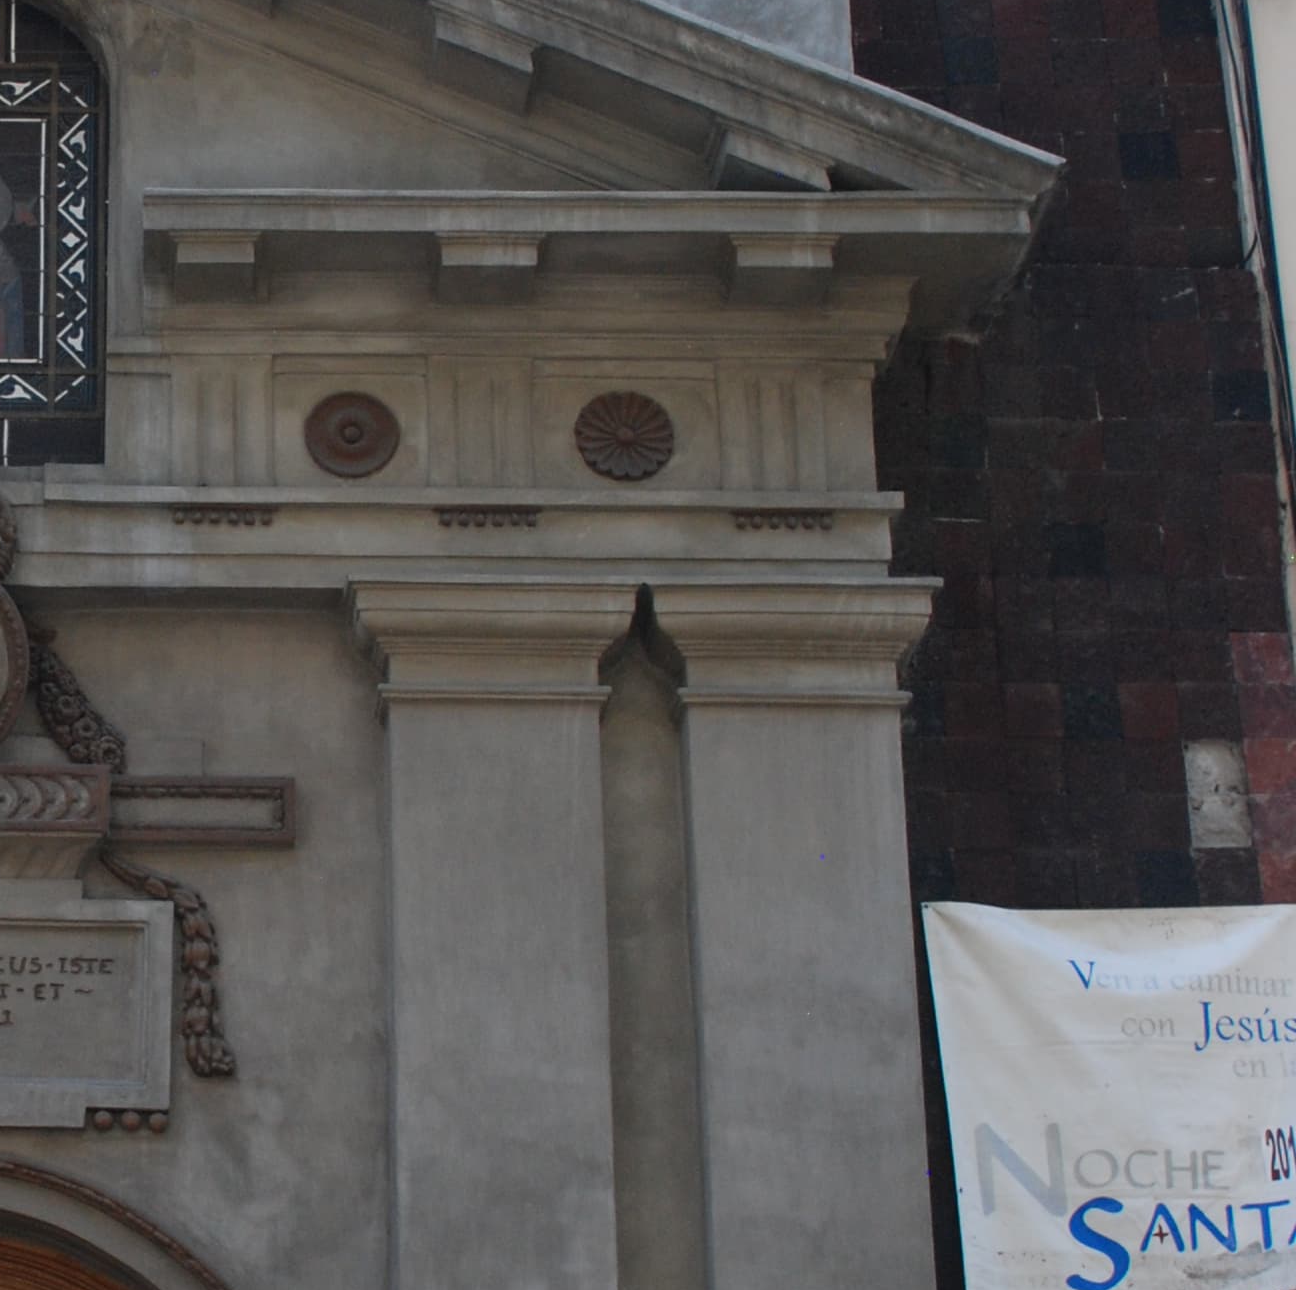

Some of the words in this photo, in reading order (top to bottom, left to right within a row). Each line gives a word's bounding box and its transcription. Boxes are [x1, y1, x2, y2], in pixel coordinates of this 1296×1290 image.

[33, 983, 65, 1001] ET
[1067, 958, 1131, 990] Ven
[1169, 967, 1293, 998] caminar
[1121, 1016, 1176, 1038] con
[1193, 1000, 1296, 1052] Jesús
[1232, 1058, 1267, 1079] en
[974, 1122, 1231, 1217] NOCHE
